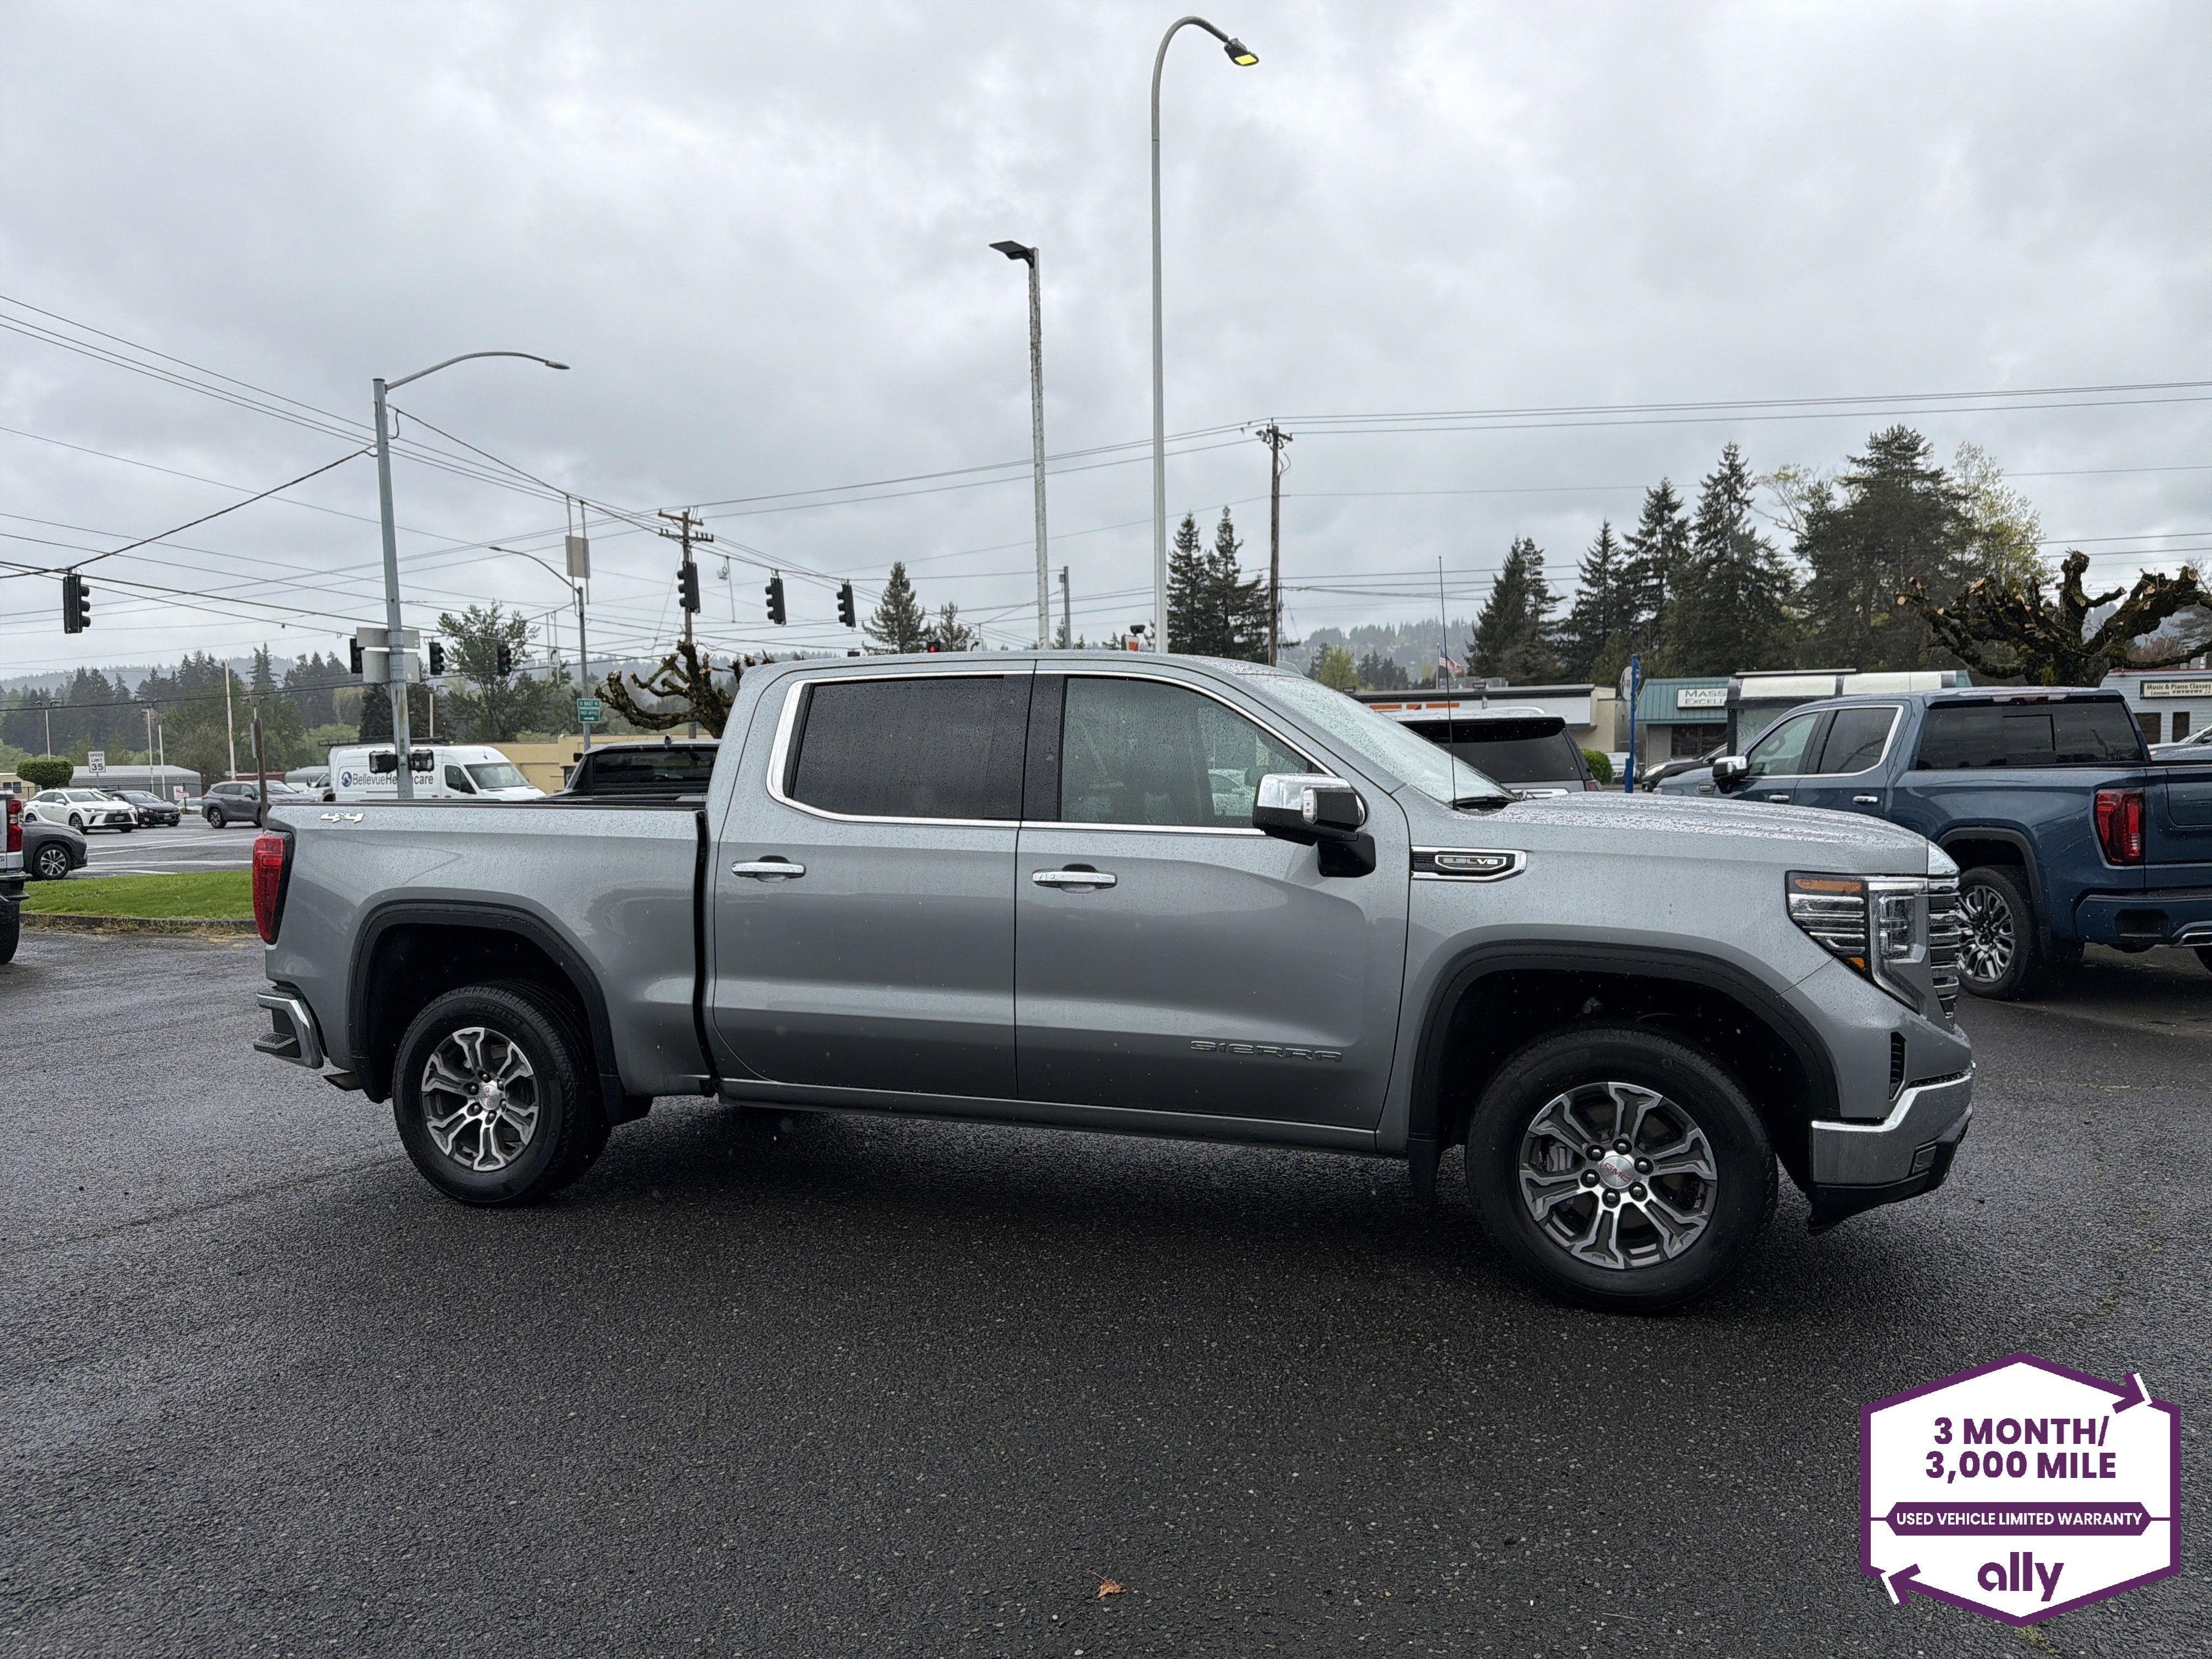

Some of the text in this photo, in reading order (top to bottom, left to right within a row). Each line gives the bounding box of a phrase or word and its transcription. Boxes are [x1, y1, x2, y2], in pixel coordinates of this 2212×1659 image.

[352, 771, 434, 785] BellevueHecare
[1190, 1040, 1342, 1062] SIERRA
[1604, 1162, 1630, 1183] GMC
